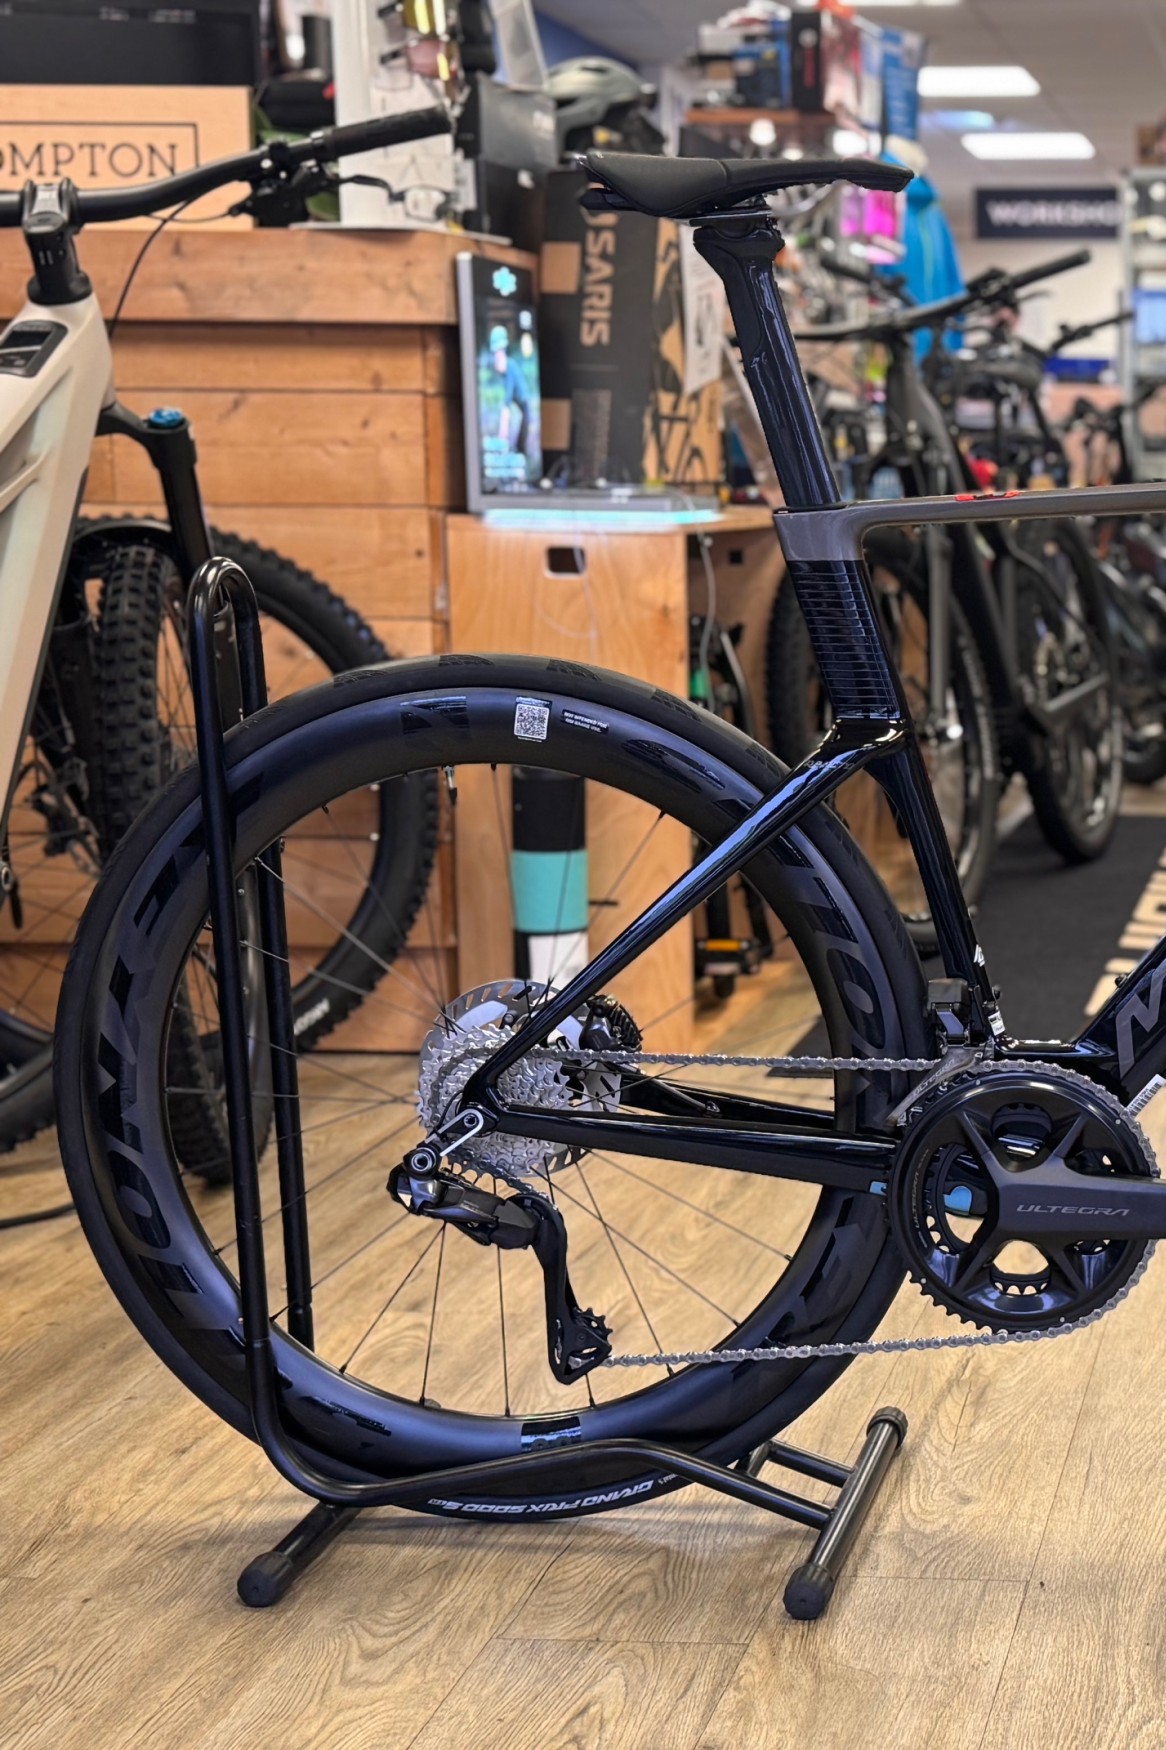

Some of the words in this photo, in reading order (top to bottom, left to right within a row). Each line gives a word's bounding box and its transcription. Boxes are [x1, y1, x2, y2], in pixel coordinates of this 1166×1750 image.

[0, 142, 177, 178] MPTON
[580, 230, 616, 346] SARIS
[1016, 1204, 1130, 1217] ULTEGRA
[580, 1480, 655, 1507] GRAND
[461, 1502, 525, 1514] 5000
[525, 1499, 581, 1513] PRIX
